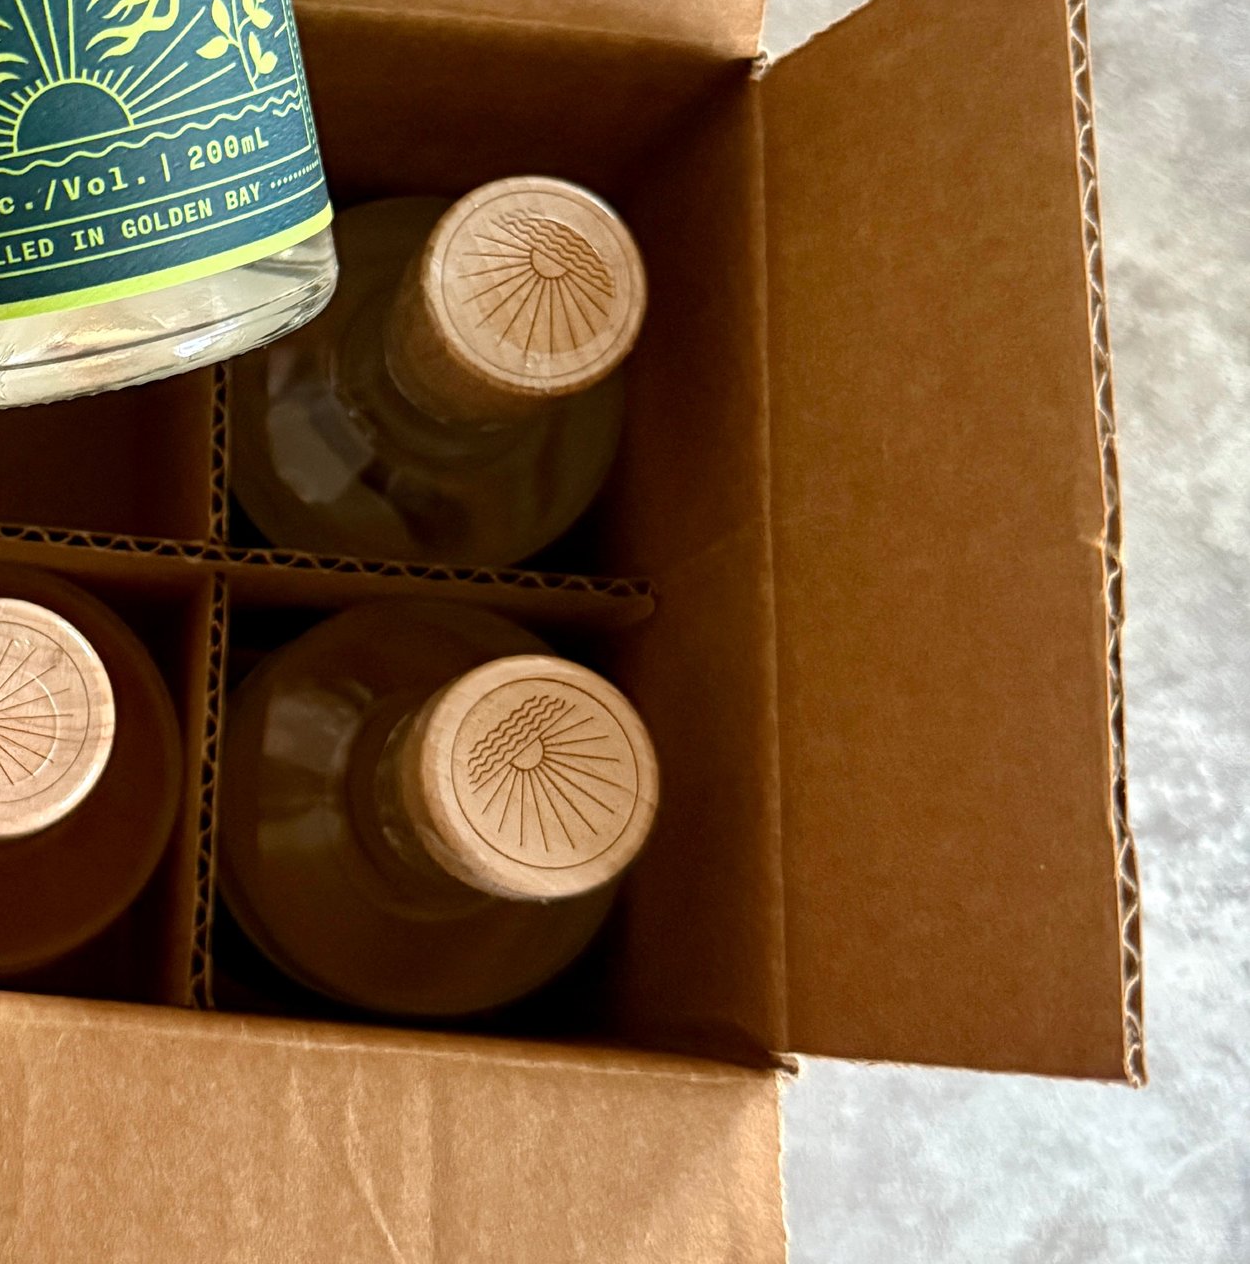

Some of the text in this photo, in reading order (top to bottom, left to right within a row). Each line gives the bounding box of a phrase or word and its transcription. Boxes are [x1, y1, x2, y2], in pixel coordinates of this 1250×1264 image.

[188, 126, 270, 171] 200mL
[72, 230, 105, 252] IN
[121, 197, 213, 239] GOLDEN
[225, 181, 262, 212] BAY
